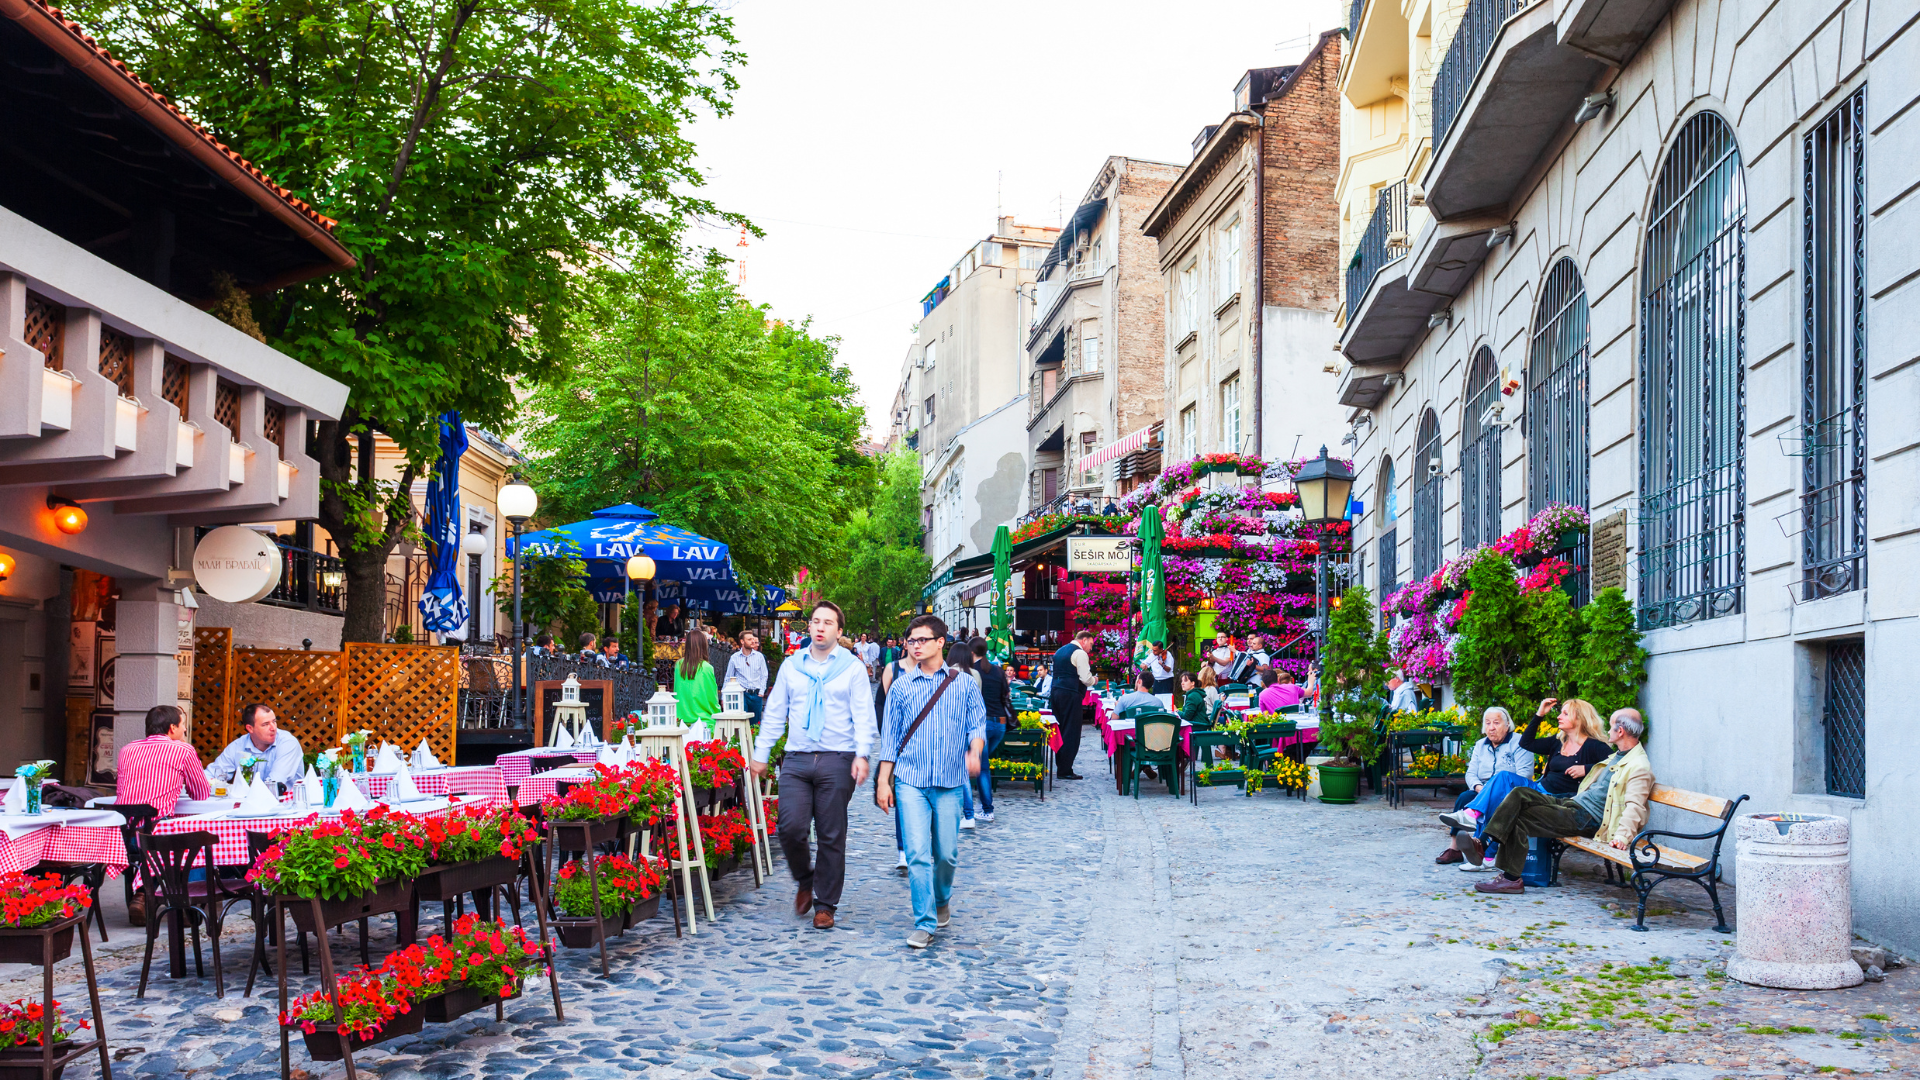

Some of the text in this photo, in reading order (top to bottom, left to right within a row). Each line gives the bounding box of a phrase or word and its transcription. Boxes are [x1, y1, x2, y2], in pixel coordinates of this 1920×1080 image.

[595, 543, 644, 557] LAV
[672, 546, 720, 560] LAV
[1074, 548, 1130, 560] ŠEŠIR MOJ
[198, 559, 261, 570] МАЛИ ВРАБАЦ
